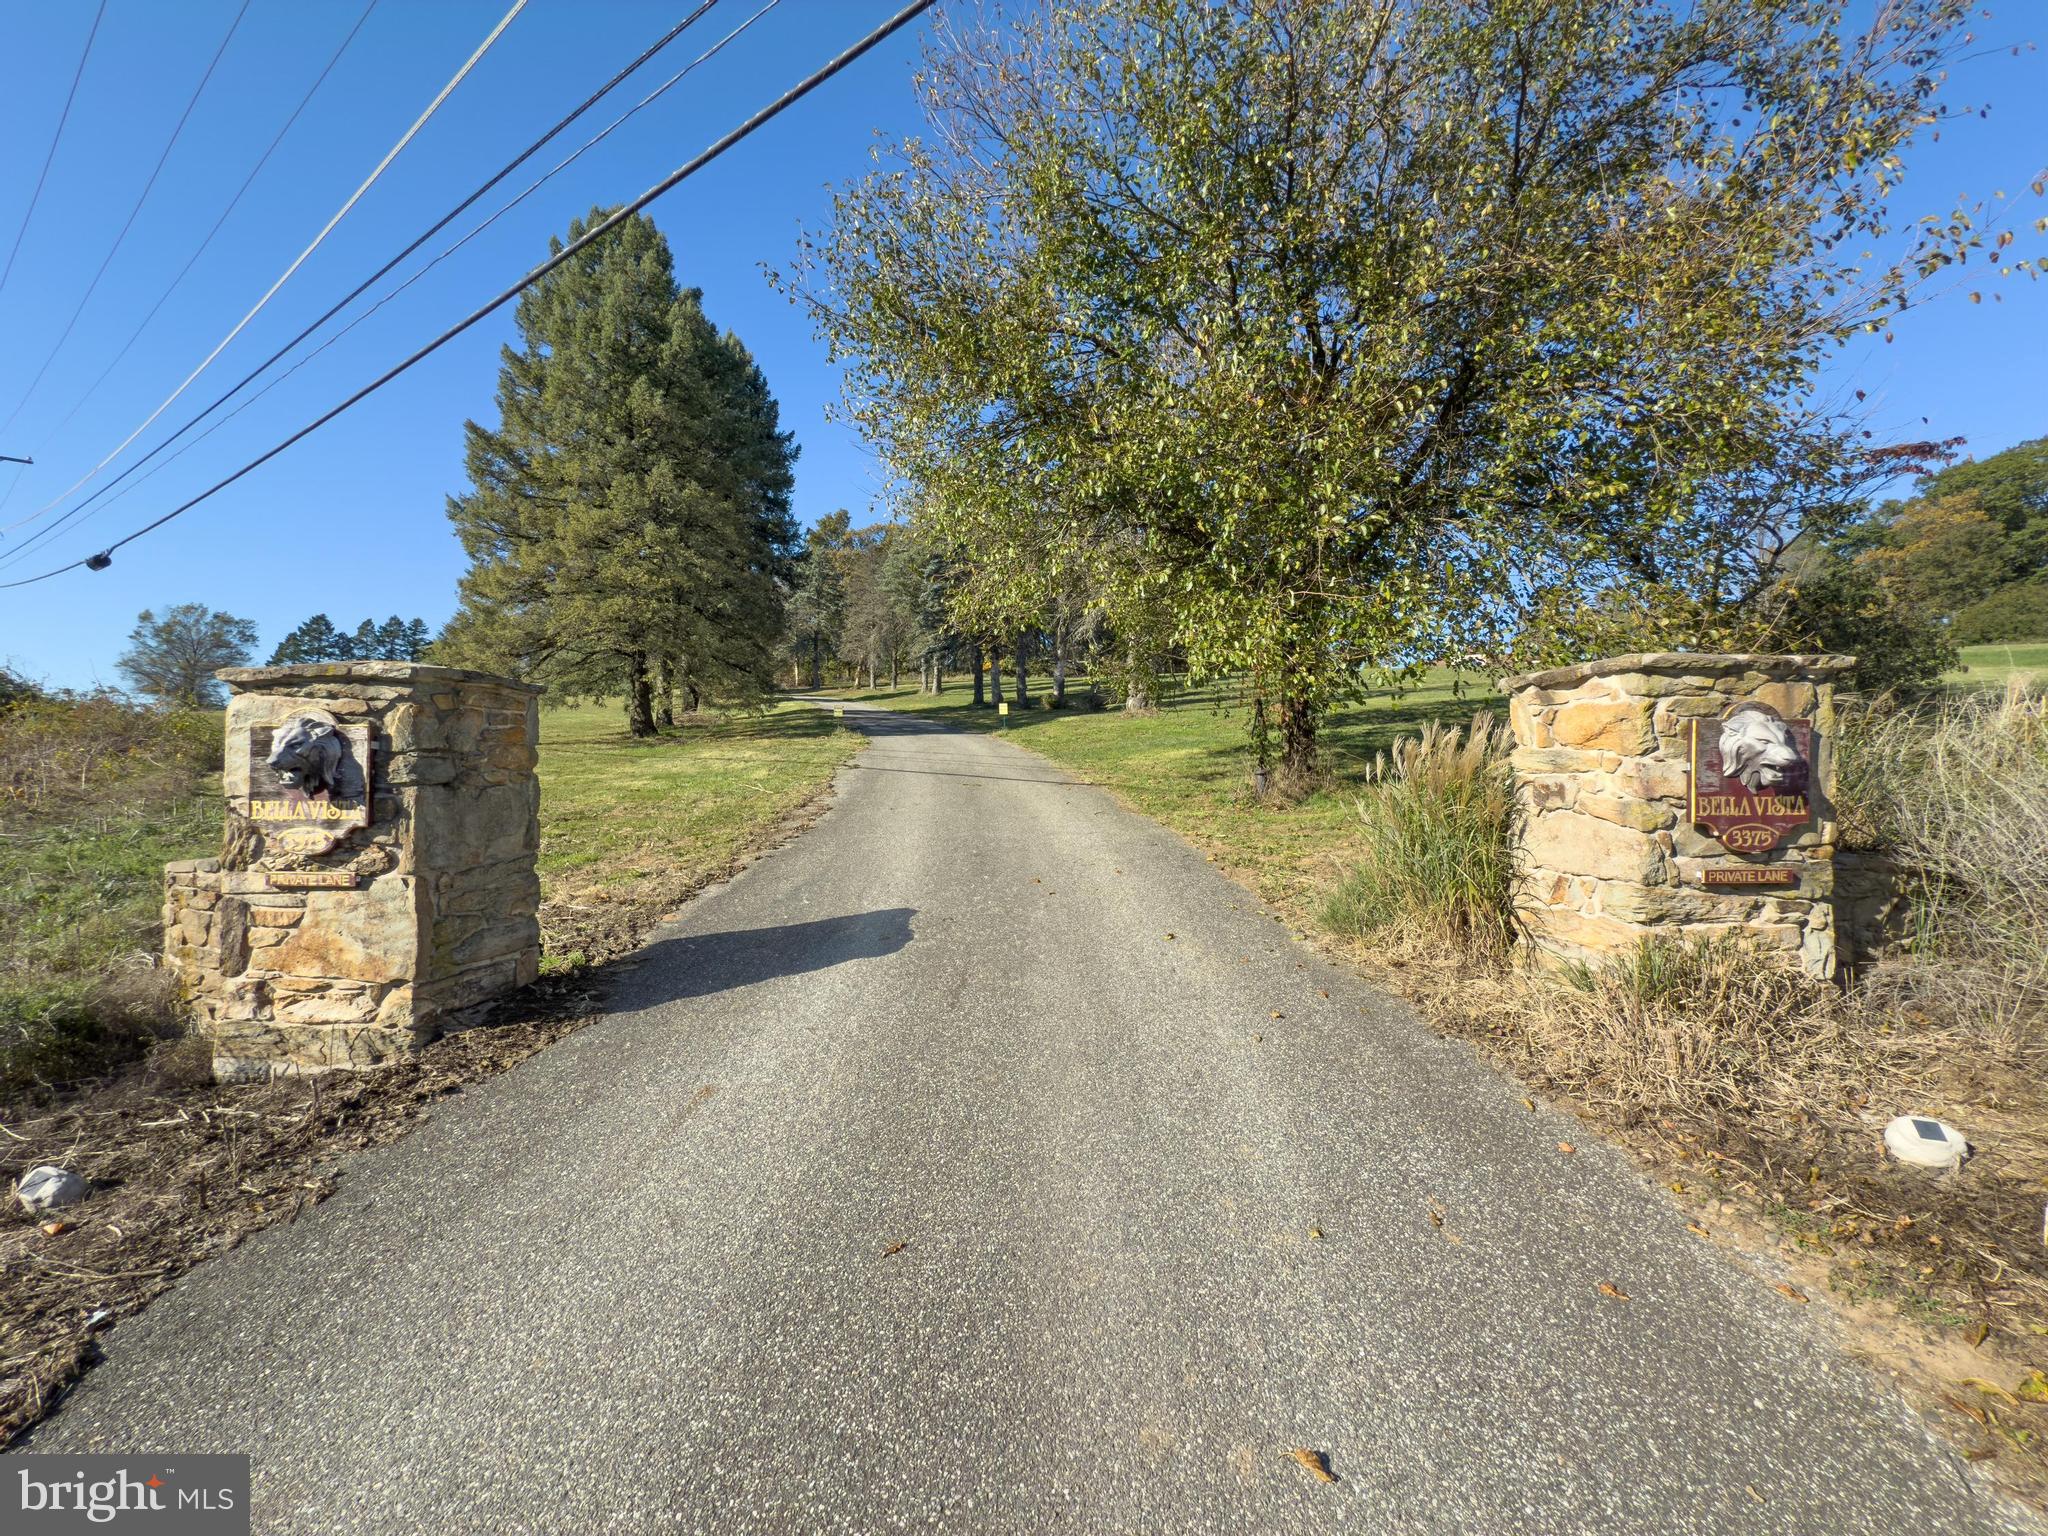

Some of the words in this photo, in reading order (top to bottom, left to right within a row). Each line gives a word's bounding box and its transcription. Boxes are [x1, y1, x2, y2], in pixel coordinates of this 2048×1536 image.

[250, 800, 306, 820] BELLA
[1698, 796, 1752, 817] BELLA
[1753, 795, 1807, 817] VISTA
[1732, 830, 1772, 847] 3375
[270, 874, 317, 886] PRIVATE
[319, 874, 350, 886] LANE
[1709, 871, 1756, 882] PRIVATE
[1758, 870, 1788, 882] LANE
